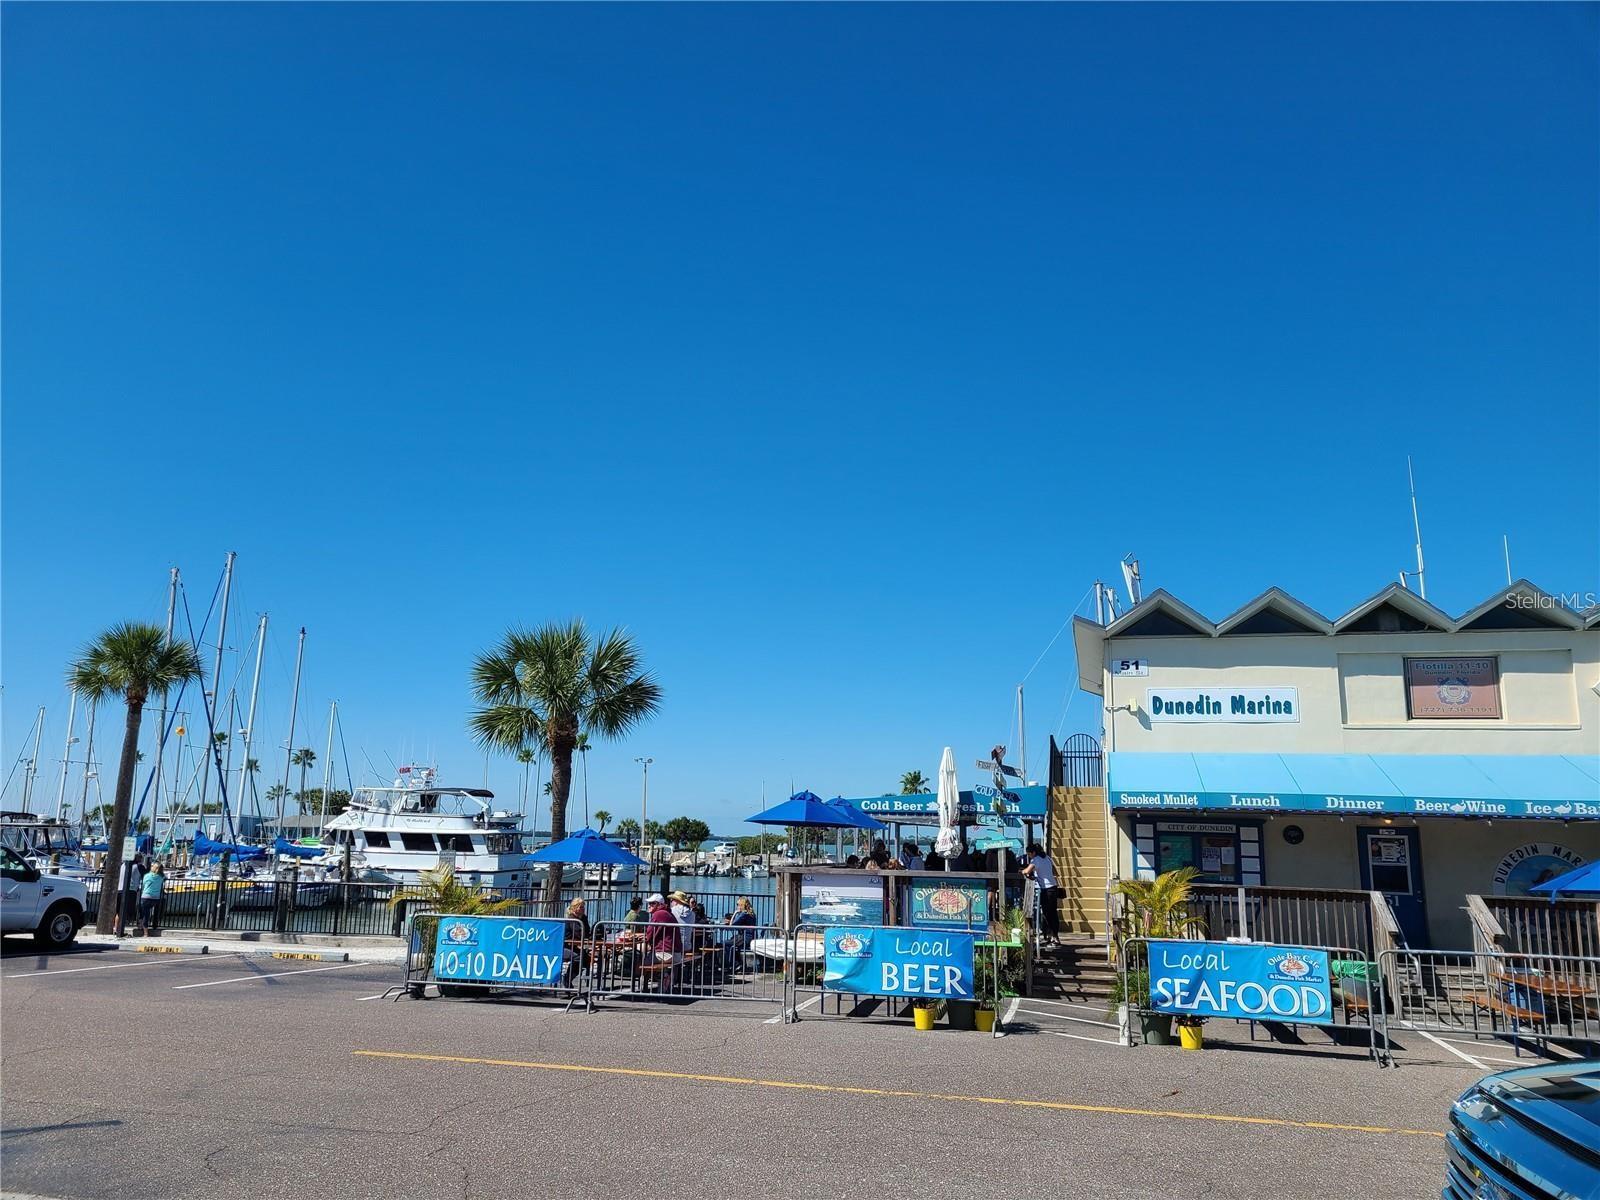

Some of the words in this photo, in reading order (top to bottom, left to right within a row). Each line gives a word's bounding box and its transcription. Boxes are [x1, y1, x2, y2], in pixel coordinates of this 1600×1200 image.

[1120, 660, 1140, 670] 51
[1416, 662, 1454, 670] Flotilla
[1458, 662, 1489, 670] 11-10
[1152, 695, 1222, 715] Dunedin
[1231, 695, 1292, 715] Marina
[975, 785, 994, 796] COLD
[861, 800, 891, 811] Cold
[894, 801, 923, 811] Beer
[1120, 793, 1161, 805] Smoked
[1163, 794, 1199, 806] Mullet
[1231, 794, 1280, 807] Lunch
[1326, 796, 1385, 810] Dinner
[1414, 799, 1450, 812] Beer
[1466, 800, 1506, 813] Wine
[956, 802, 985, 812] resh
[1525, 802, 1552, 814] Ice
[1200, 824, 1234, 832] DUNEDIN
[1494, 844, 1540, 884] DUNEDIN
[1552, 845, 1584, 866] MAR
[915, 885, 937, 901] Olde
[940, 881, 957, 892] Bay
[501, 925, 549, 948] Open
[896, 938, 952, 958] Local
[439, 951, 485, 977] 10-10
[492, 953, 559, 980] DAILY
[1163, 950, 1231, 971] Local
[1267, 954, 1285, 966] Olde
[1286, 952, 1303, 961] Bay
[882, 962, 967, 995] BEER
[1156, 977, 1327, 1017] SEAFOOD
